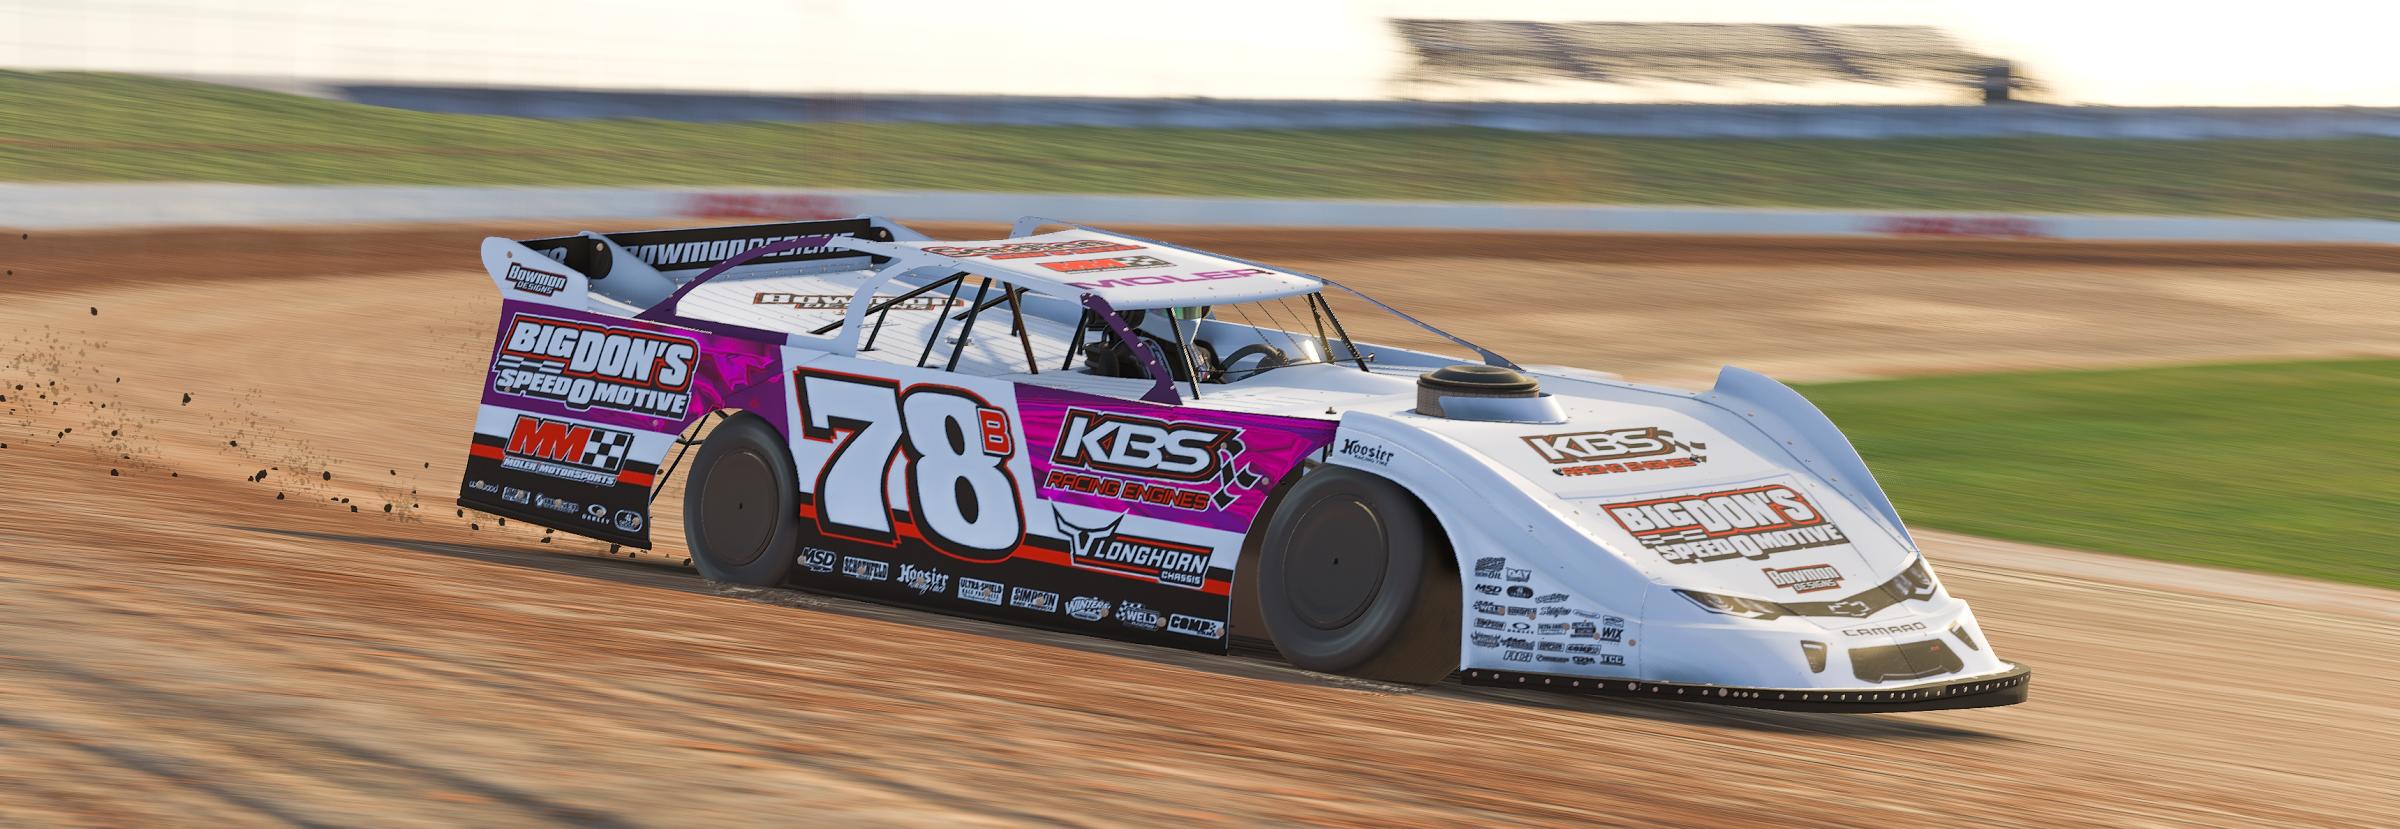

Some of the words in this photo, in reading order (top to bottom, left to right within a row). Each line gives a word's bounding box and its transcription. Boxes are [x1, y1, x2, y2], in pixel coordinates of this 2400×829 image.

[517, 281, 553, 294] DESIGNS
[506, 416, 593, 464] MM
[1060, 415, 1220, 474] KBS
[1341, 439, 1394, 462] Hoosier
[1529, 429, 1665, 461] KBS
[502, 458, 537, 471] MOLER
[537, 464, 616, 485] MOTORSPORTS
[801, 373, 1021, 553] 78
[1047, 471, 1121, 497] RACING
[1122, 482, 1212, 511] ENGINES
[1094, 540, 1209, 573] LONGHORN
[1160, 571, 1202, 585] CHASSIS
[1475, 584, 1502, 593] MSD
[1126, 610, 1157, 625] WELD
[1170, 616, 1211, 632] COMP
[1842, 621, 1928, 637] CAMARO
[1602, 627, 1623, 639] WIX
